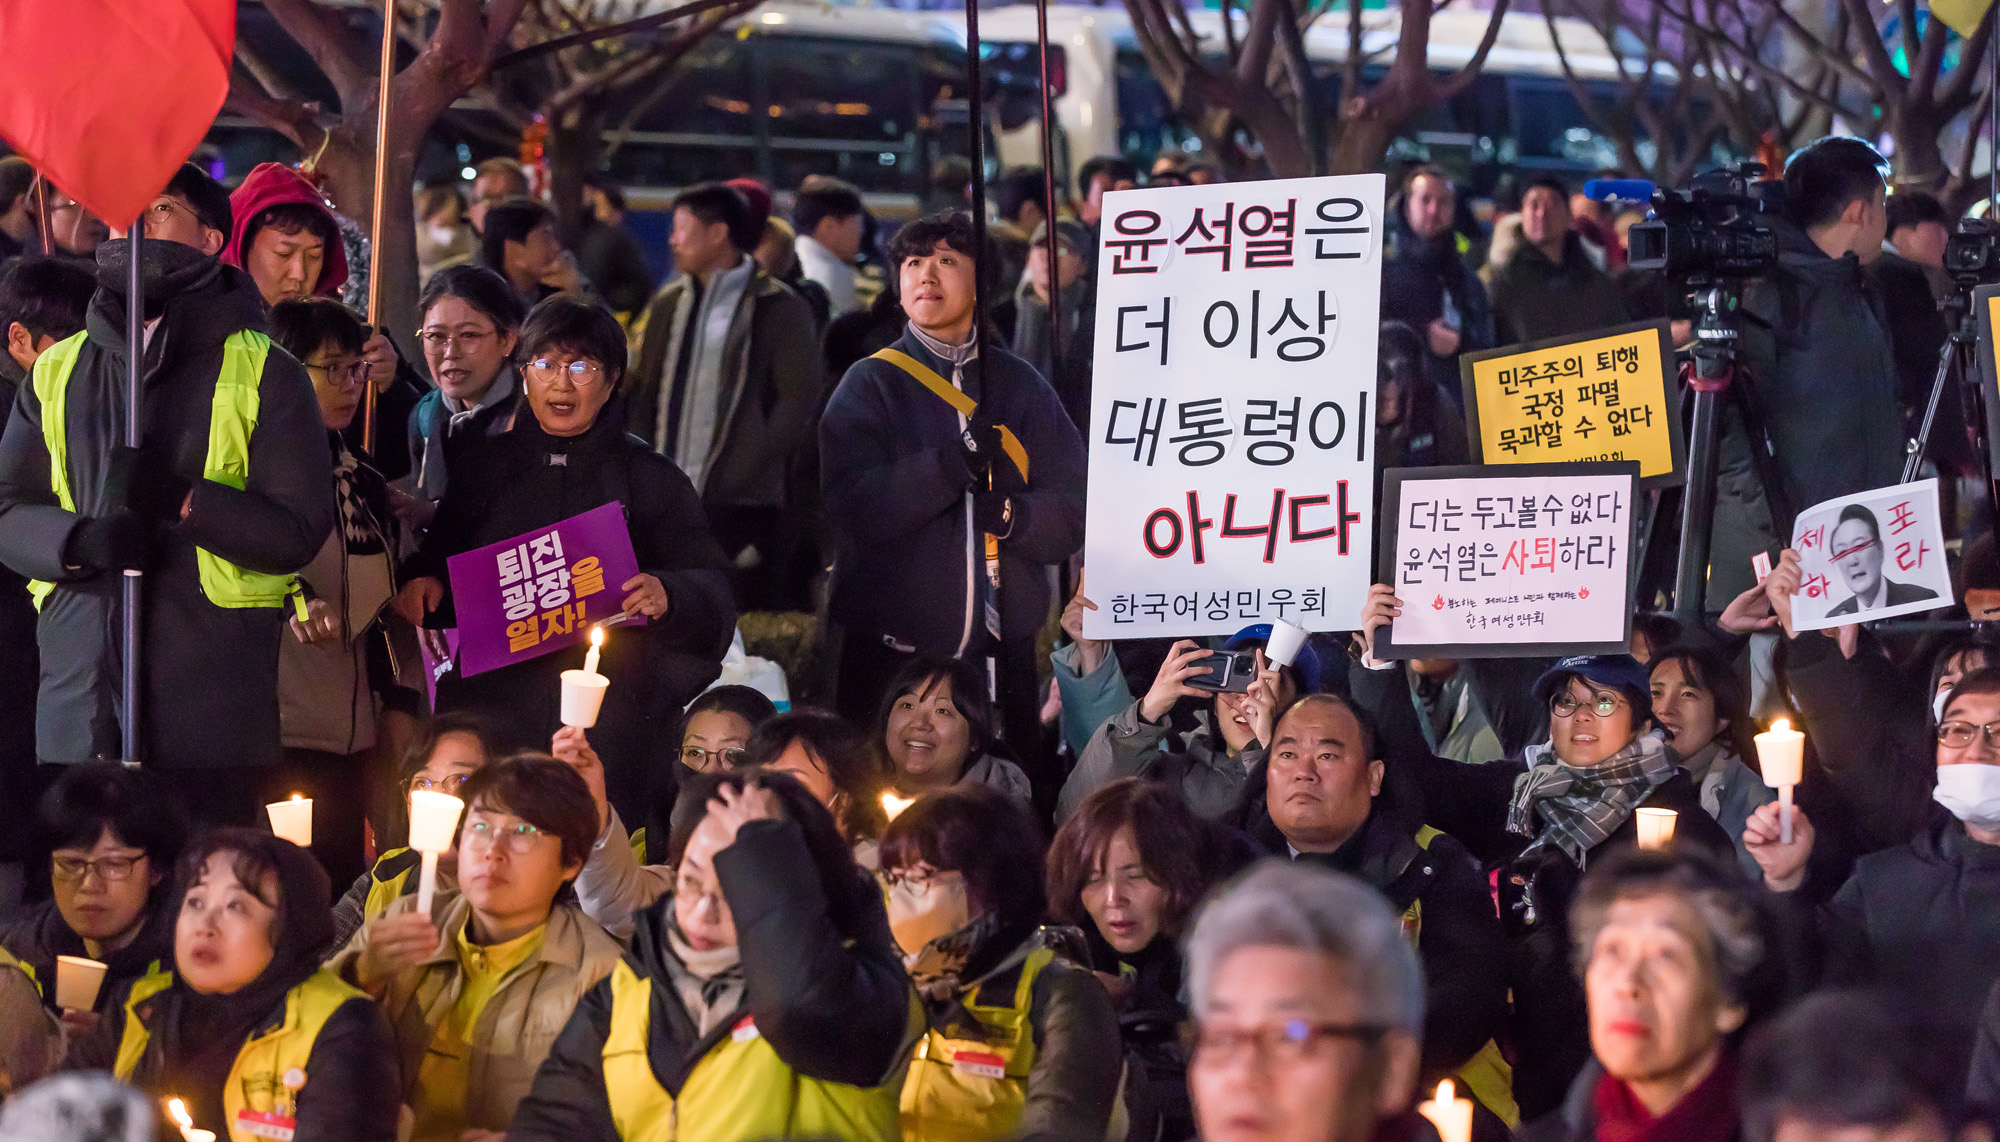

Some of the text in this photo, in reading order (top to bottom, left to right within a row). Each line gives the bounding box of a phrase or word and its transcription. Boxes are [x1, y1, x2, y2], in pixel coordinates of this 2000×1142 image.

[1104, 197, 1370, 275] 윤석열은
[1115, 290, 1337, 366] 더 이상
[1498, 345, 1639, 395] 민주주의 퇴행
[1521, 379, 1621, 420] 국정 파멸
[1105, 391, 1368, 467] 대통령이
[1498, 404, 1653, 455] 묵과할 수 없다
[1142, 480, 1361, 565] 아니다
[1409, 498, 1464, 532] 더는
[1570, 490, 1622, 525] 없다
[496, 530, 566, 587] 퇴진
[1403, 535, 1617, 585] 윤석열은 사퇴하라
[502, 556, 606, 621] 광장을
[1111, 586, 1327, 624] 한국여성민우회
[505, 600, 588, 653] 열자!
